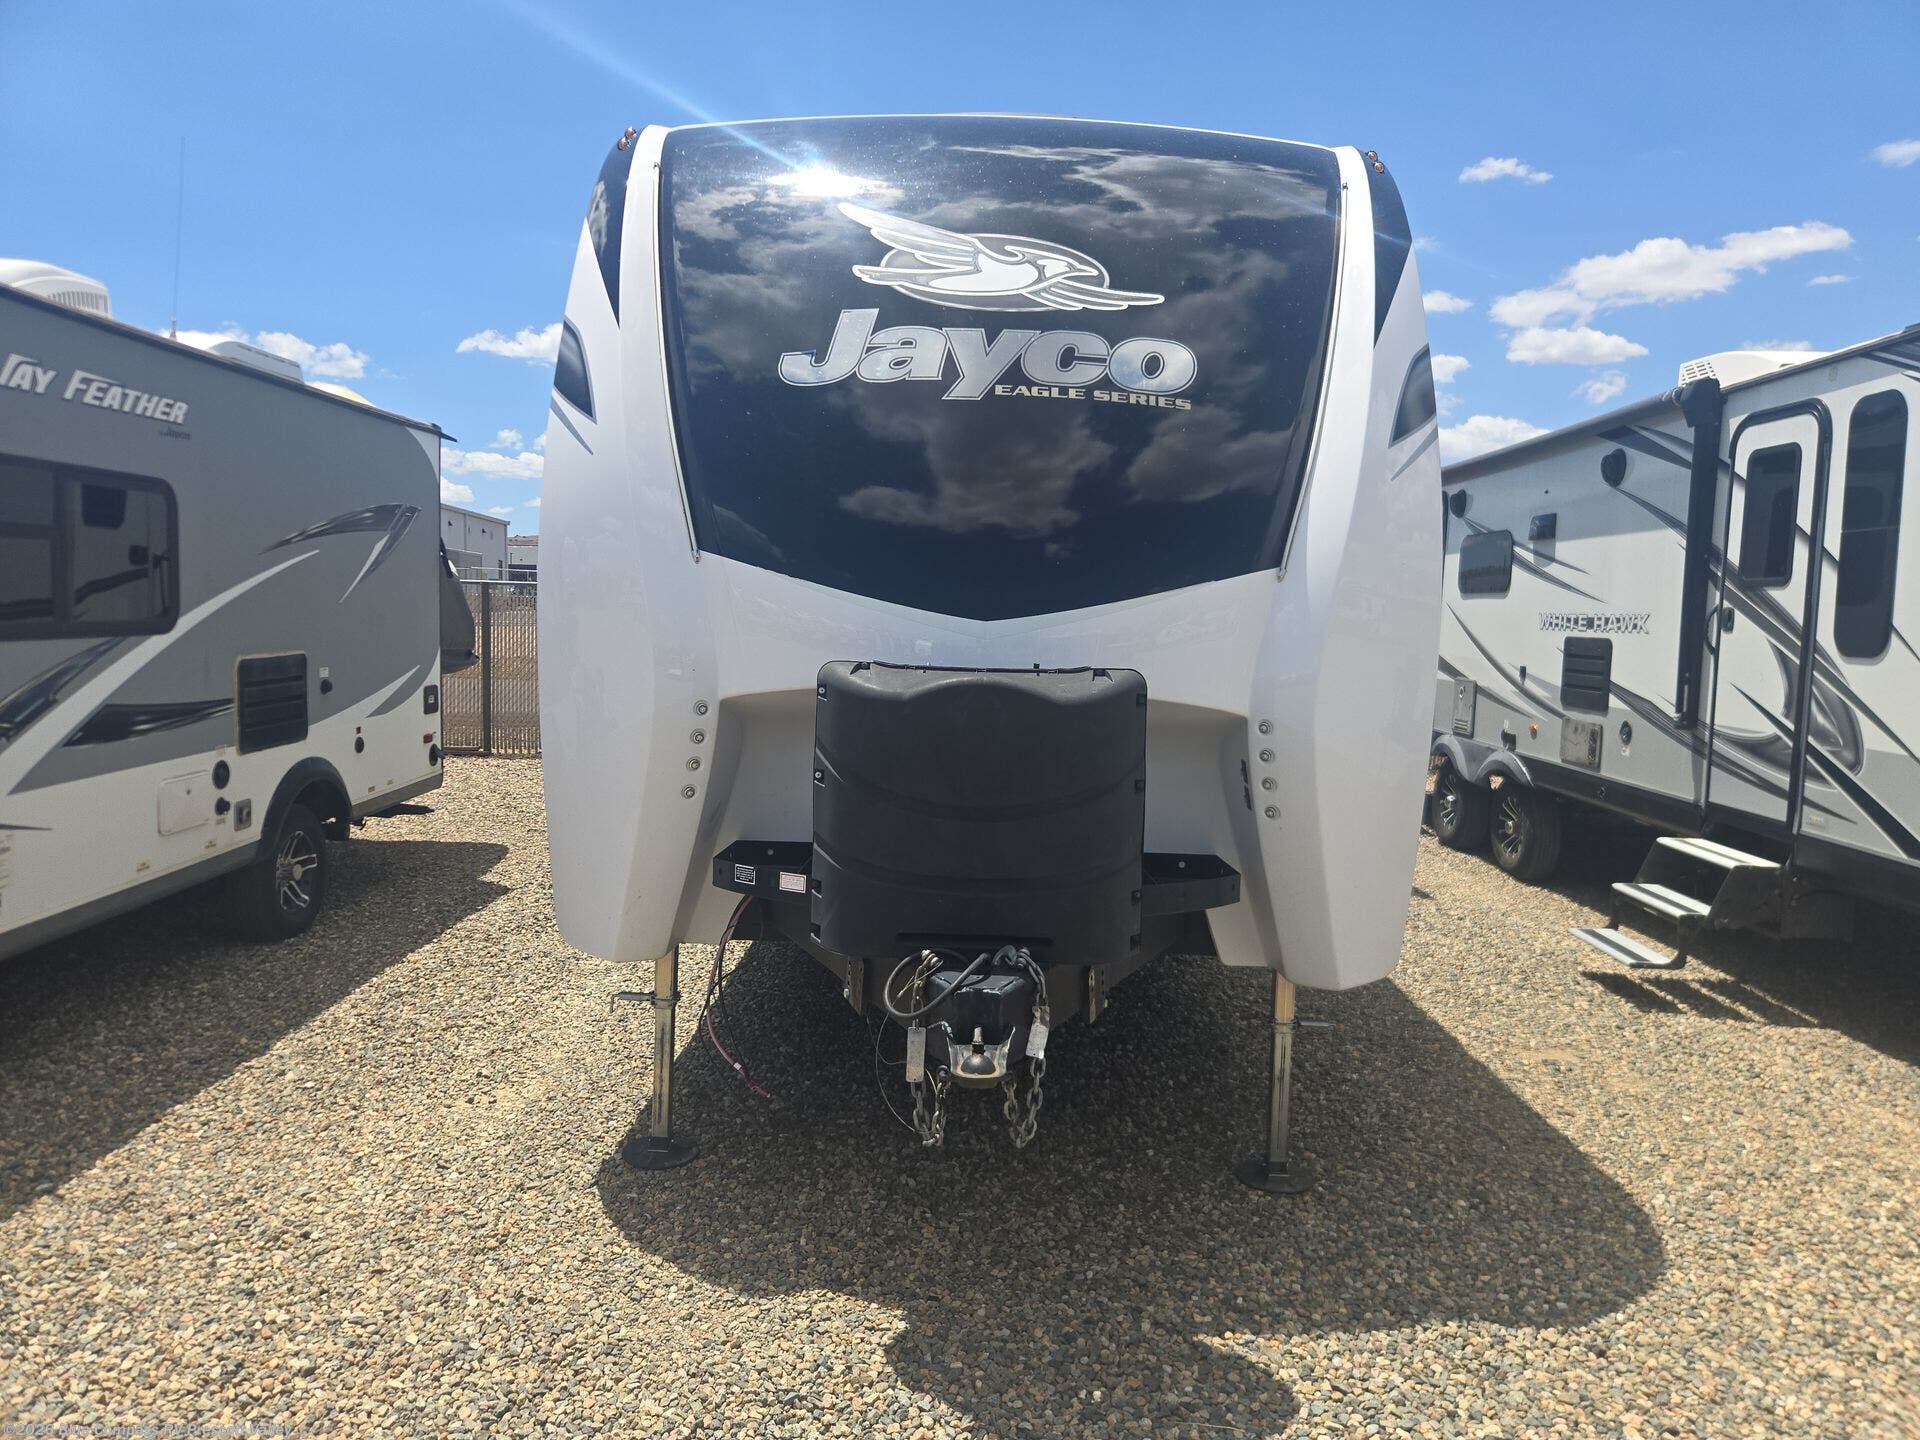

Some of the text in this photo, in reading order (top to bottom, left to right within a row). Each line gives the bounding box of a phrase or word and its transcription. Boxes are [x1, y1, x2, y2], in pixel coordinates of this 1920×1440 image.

[778, 307, 1198, 400] Jayco
[63, 369, 189, 425] FEATHER
[994, 384, 1192, 411] EAGLE SERIES
[1539, 612, 1650, 635] WHITE HAWK
